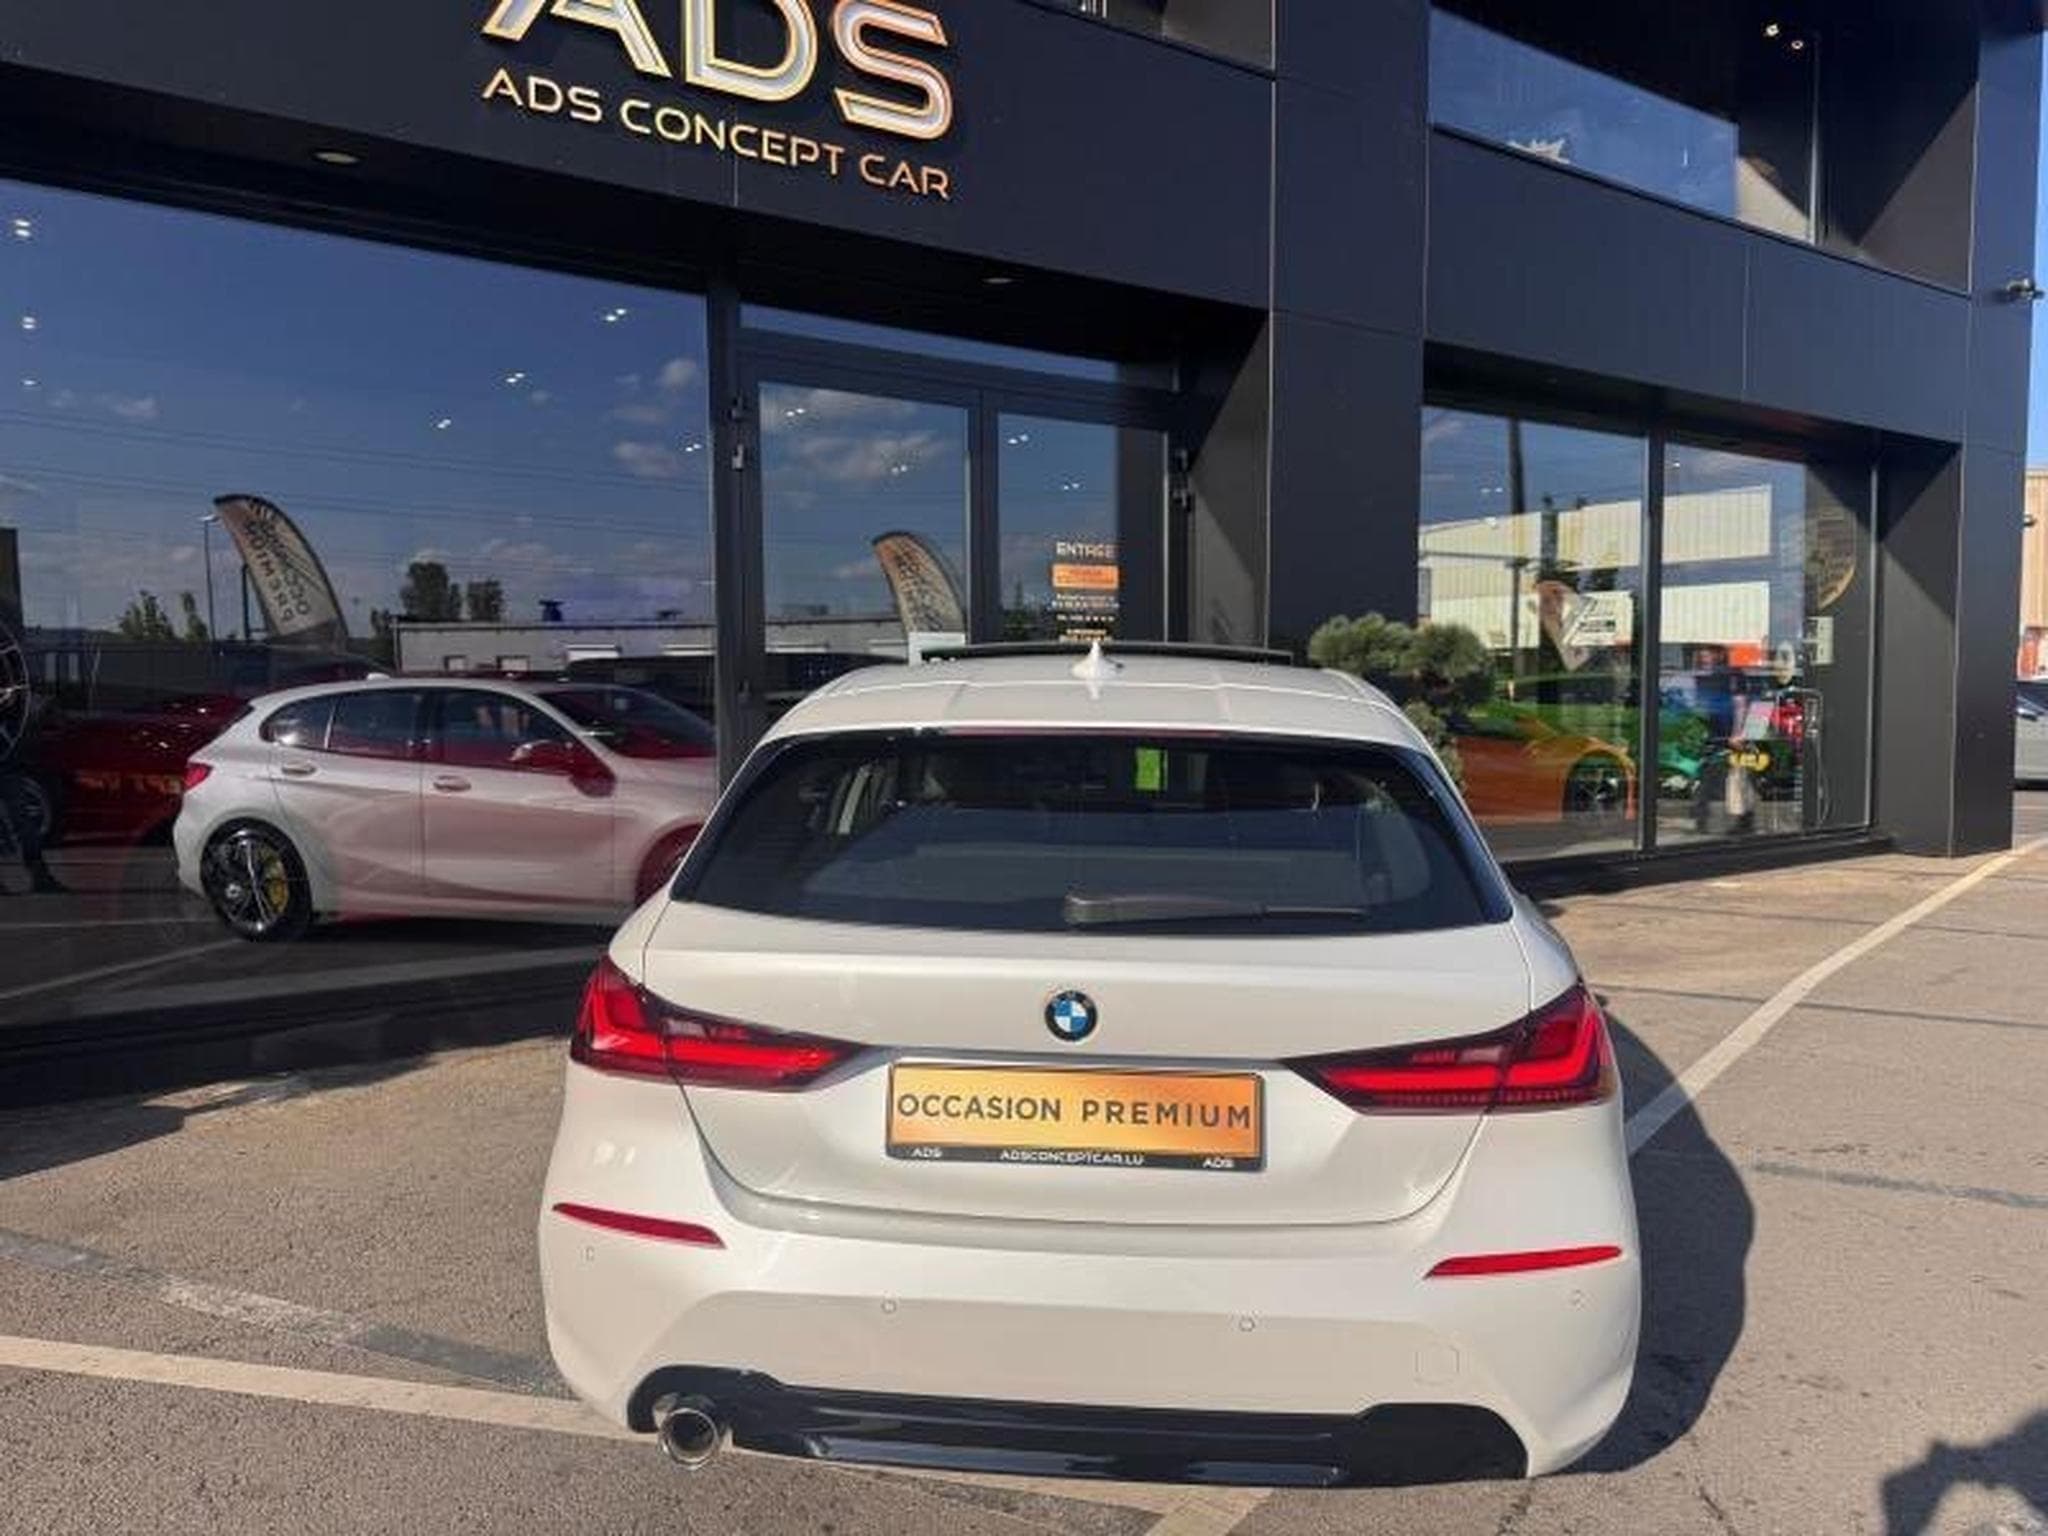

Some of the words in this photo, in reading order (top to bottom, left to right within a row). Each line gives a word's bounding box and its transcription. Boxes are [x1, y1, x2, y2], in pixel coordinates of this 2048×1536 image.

[482, 68, 603, 123] ADS
[620, 99, 845, 177] CONCEPT
[859, 154, 950, 200] CAR
[898, 1093, 1062, 1122] OCCASION
[1082, 1099, 1252, 1130] PREMIUM
[911, 1147, 943, 1159] ADS
[1202, 1156, 1235, 1169] ADS
